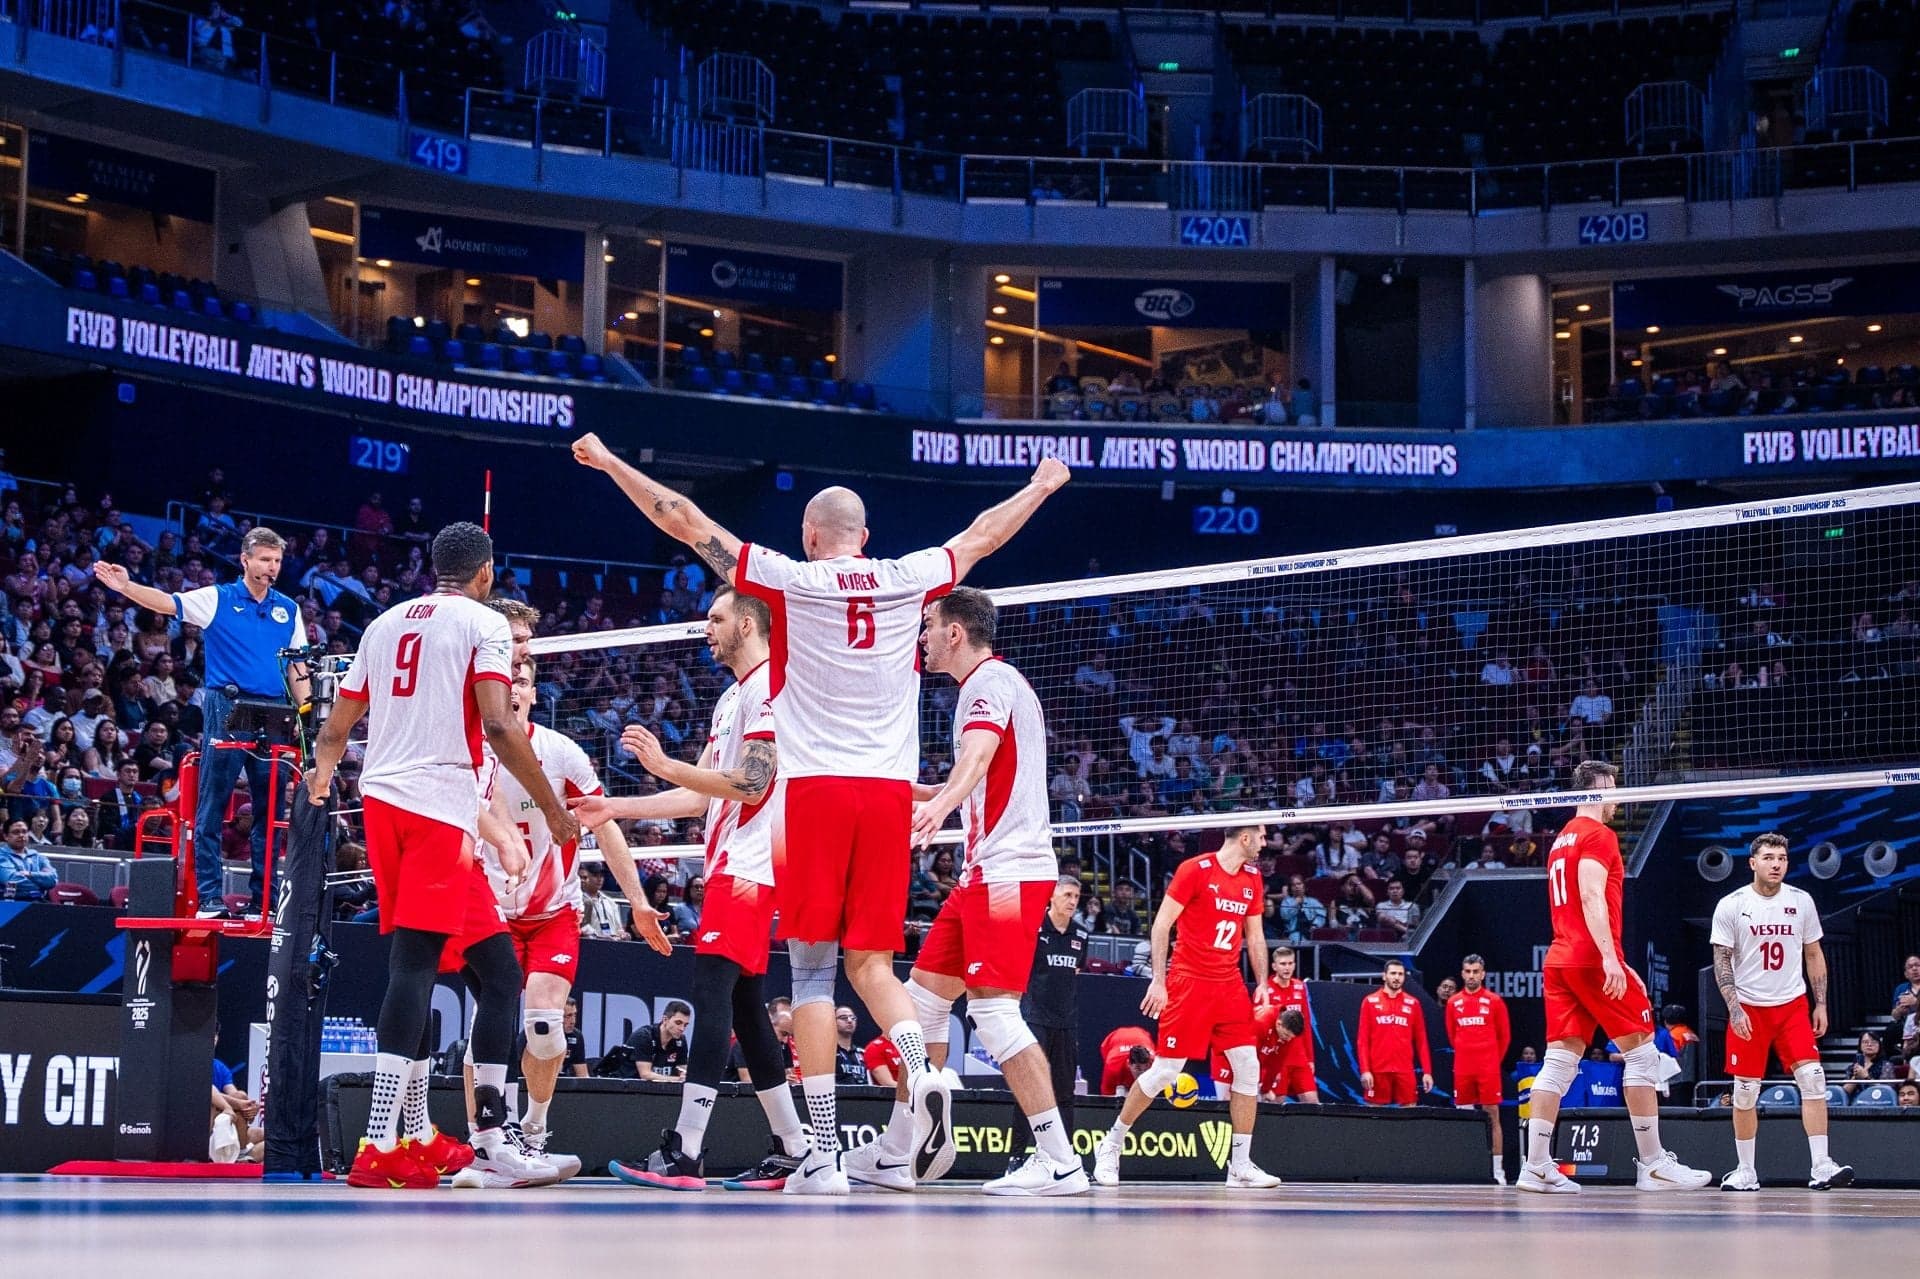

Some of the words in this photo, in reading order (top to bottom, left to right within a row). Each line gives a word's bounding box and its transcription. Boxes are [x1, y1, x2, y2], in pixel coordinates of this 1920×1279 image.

[416, 136, 462, 173] 419
[1183, 217, 1248, 245] 420A
[1581, 214, 1646, 242] 420B
[1739, 284, 1833, 307] PAGSS
[67, 307, 117, 350] FIVB
[122, 317, 241, 375] VOLLEYBALL
[246, 344, 316, 389] MEN'S
[320, 357, 393, 405] WORLD
[396, 372, 574, 428] CHAMPIONSHIPS
[357, 437, 402, 472] 219
[912, 430, 960, 464] FIVB
[964, 434, 1094, 467] VOLLEYBALL
[1100, 437, 1177, 469] MEN'S
[1182, 438, 1266, 472] WORLD
[1270, 441, 1457, 476] CHAMPIONSHIPS
[1743, 431, 1795, 464] FIVB
[1801, 423, 1920, 461] VOLLEYBAL
[1198, 507, 1259, 534] 220
[837, 572, 880, 591] KUREK
[405, 604, 437, 619] LEON
[846, 596, 876, 649] 6
[391, 632, 422, 698] 9
[1891, 772, 1920, 781] VOLLEYBAL
[1549, 858, 1567, 906] 17
[1214, 920, 1237, 950] 12
[1750, 924, 1794, 936] VESTEL
[1047, 954, 1078, 969] VESTEL
[1760, 941, 1785, 971] 19
[44, 1054, 121, 1126] CIT
[127, 1124, 151, 1134] Senoh
[1571, 1125, 1600, 1147] 71.3
[1573, 1149, 1593, 1162] km/h
